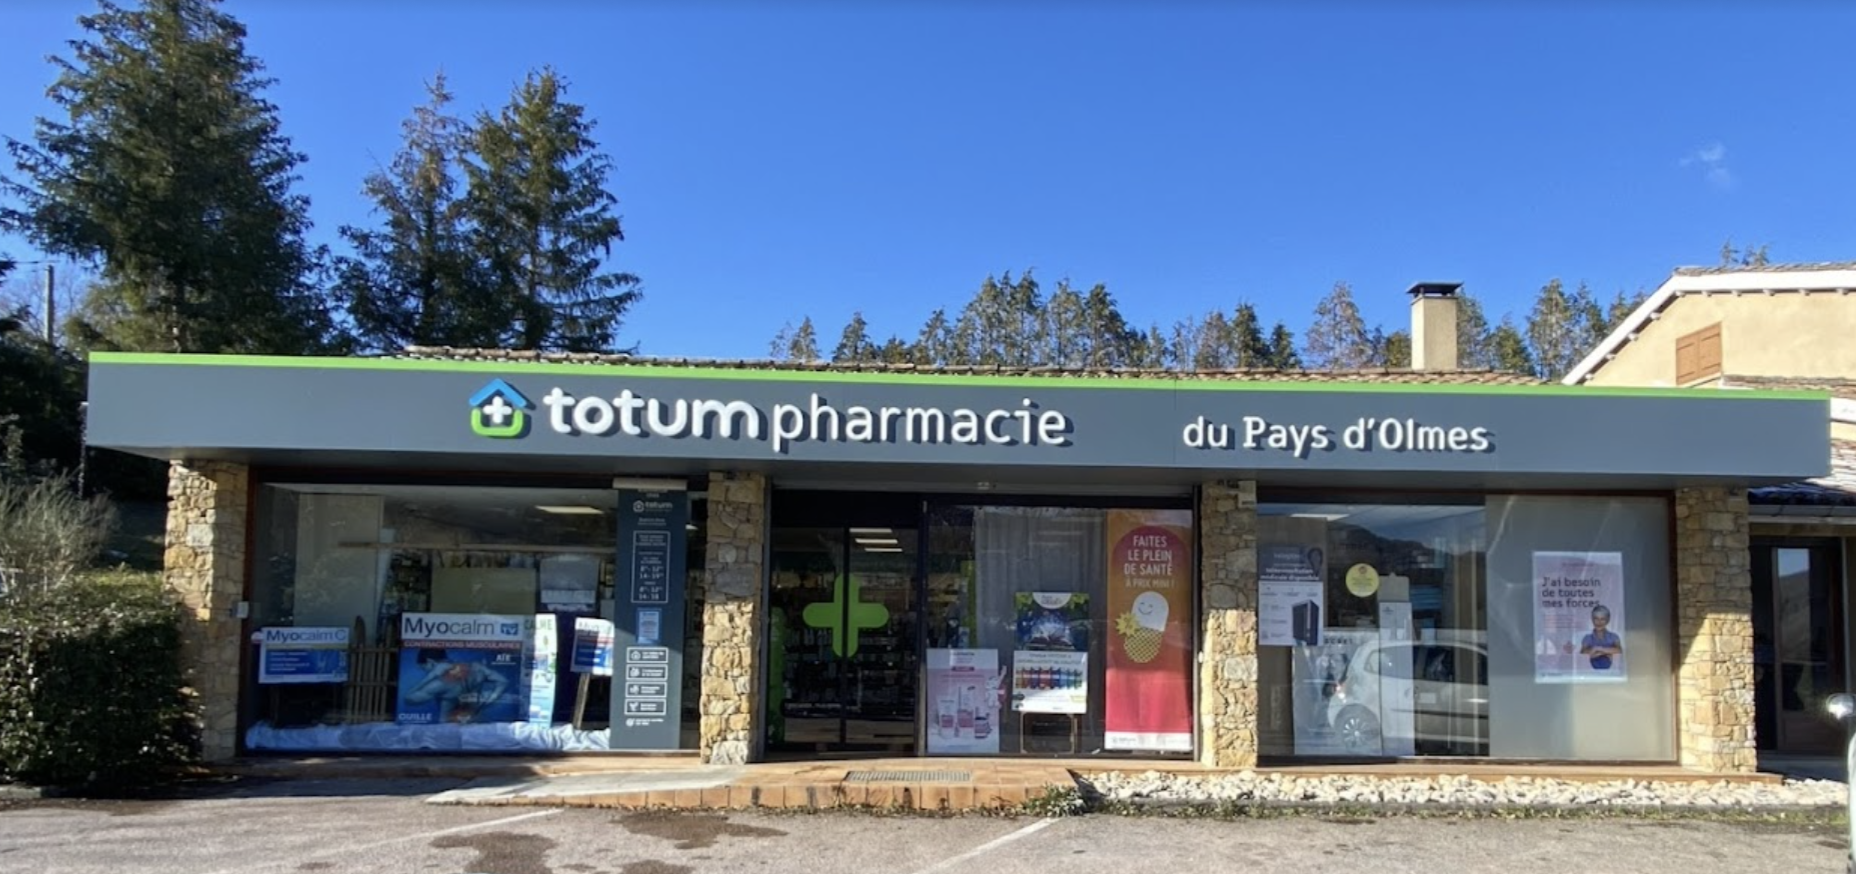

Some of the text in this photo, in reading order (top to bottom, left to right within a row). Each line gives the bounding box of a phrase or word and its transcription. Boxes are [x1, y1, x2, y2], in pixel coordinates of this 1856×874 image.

[543, 387, 1068, 453] totum pharmacie
[1183, 416, 1489, 458] du Pays d'Olmes
[1133, 535, 1167, 547] FAITES
[1128, 549, 1172, 561] LE PLEIN
[1124, 560, 1173, 576] DE SANTÉ
[1133, 578, 1151, 588] PRIX
[1152, 579, 1169, 588] MINI
[1542, 577, 1601, 587] J'ai besoin
[1542, 588, 1595, 598] de toutes
[1542, 599, 1563, 607] mes
[404, 617, 517, 637] Myocalm TV
[266, 629, 346, 643] Myocalm C
